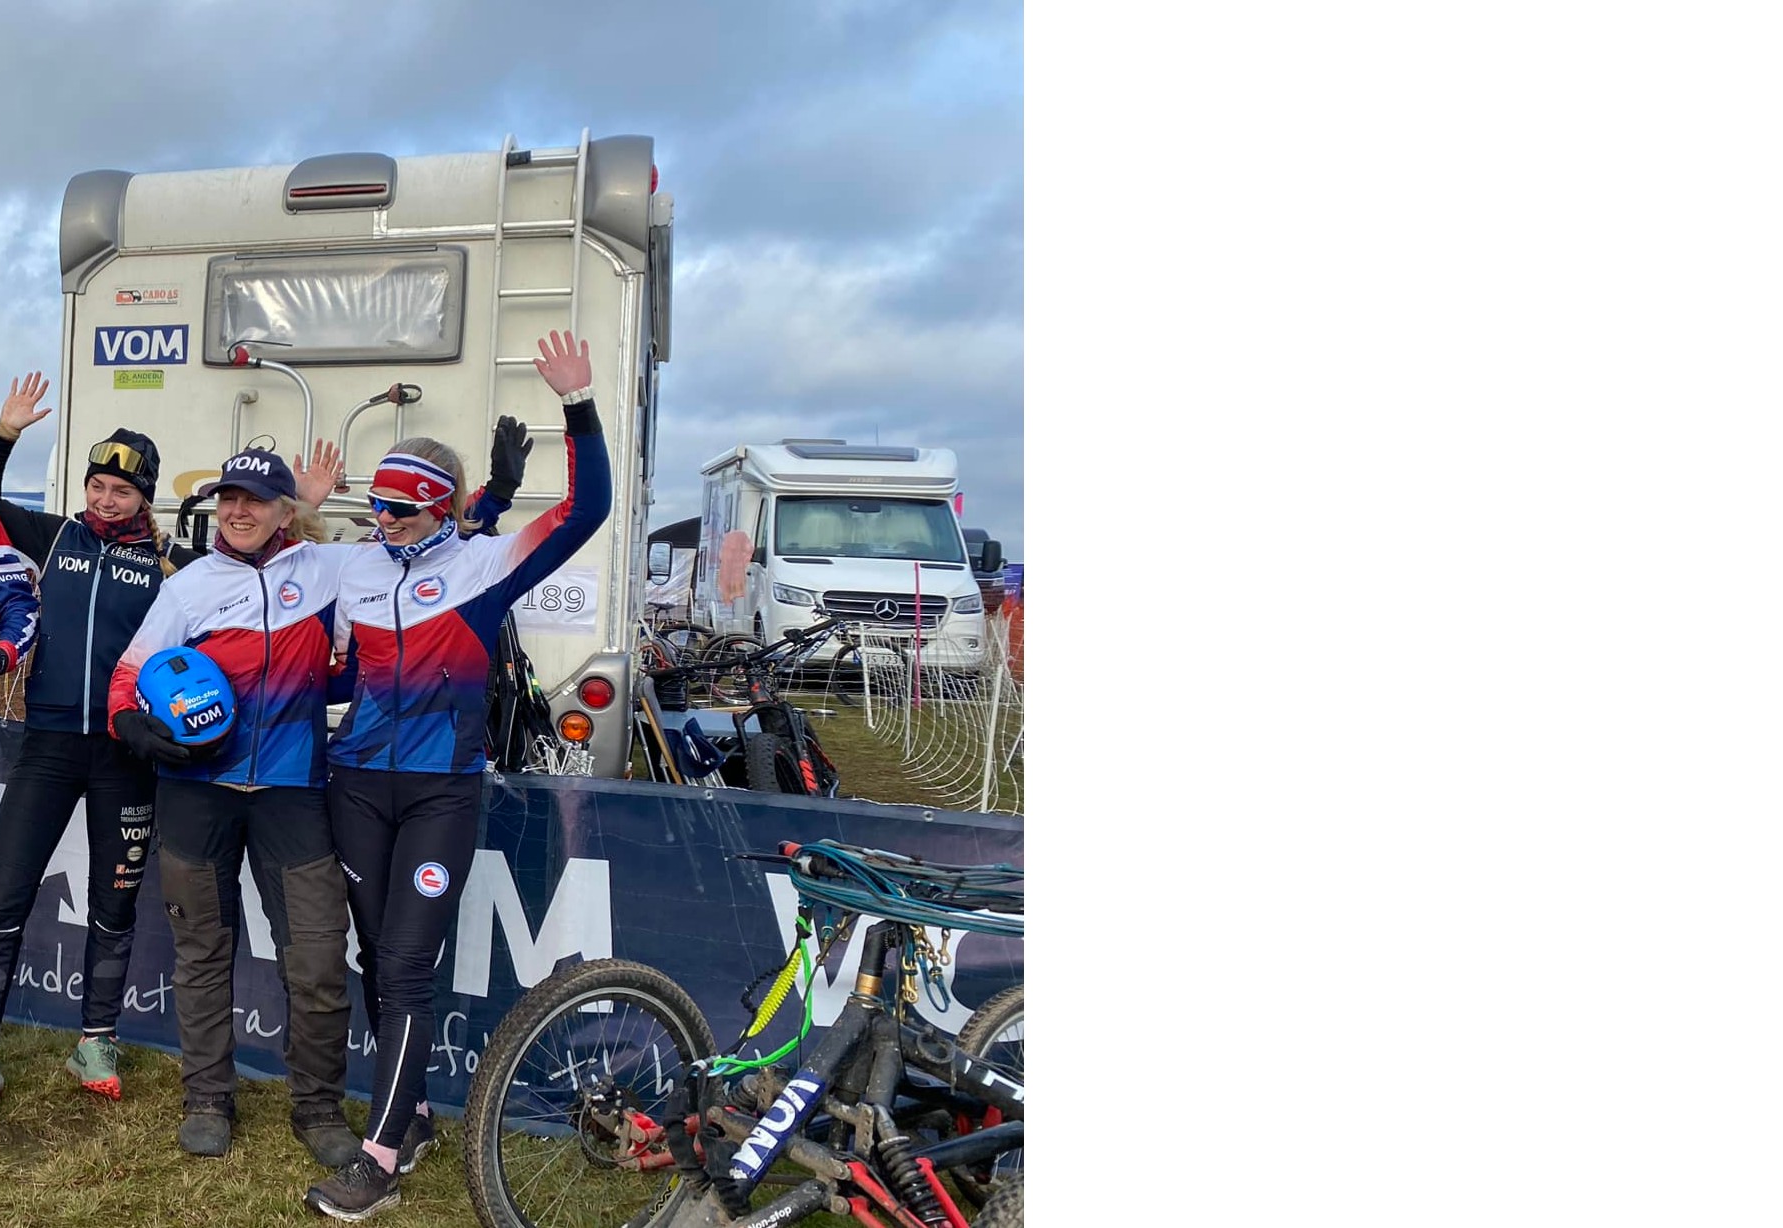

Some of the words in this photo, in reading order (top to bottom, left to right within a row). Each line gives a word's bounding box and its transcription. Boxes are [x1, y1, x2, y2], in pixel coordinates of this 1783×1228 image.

[100, 329, 184, 361] VOM
[226, 456, 271, 476] VOM
[58, 556, 90, 574] VOM
[111, 549, 154, 566] LEEGAARD
[112, 565, 150, 588] VOM
[521, 584, 585, 613] 189
[184, 688, 220, 707] Non-stop
[186, 705, 223, 729] VOM
[121, 826, 151, 841] VOM
[339, 860, 363, 883] IMTEX
[732, 1079, 819, 1170] VOM
